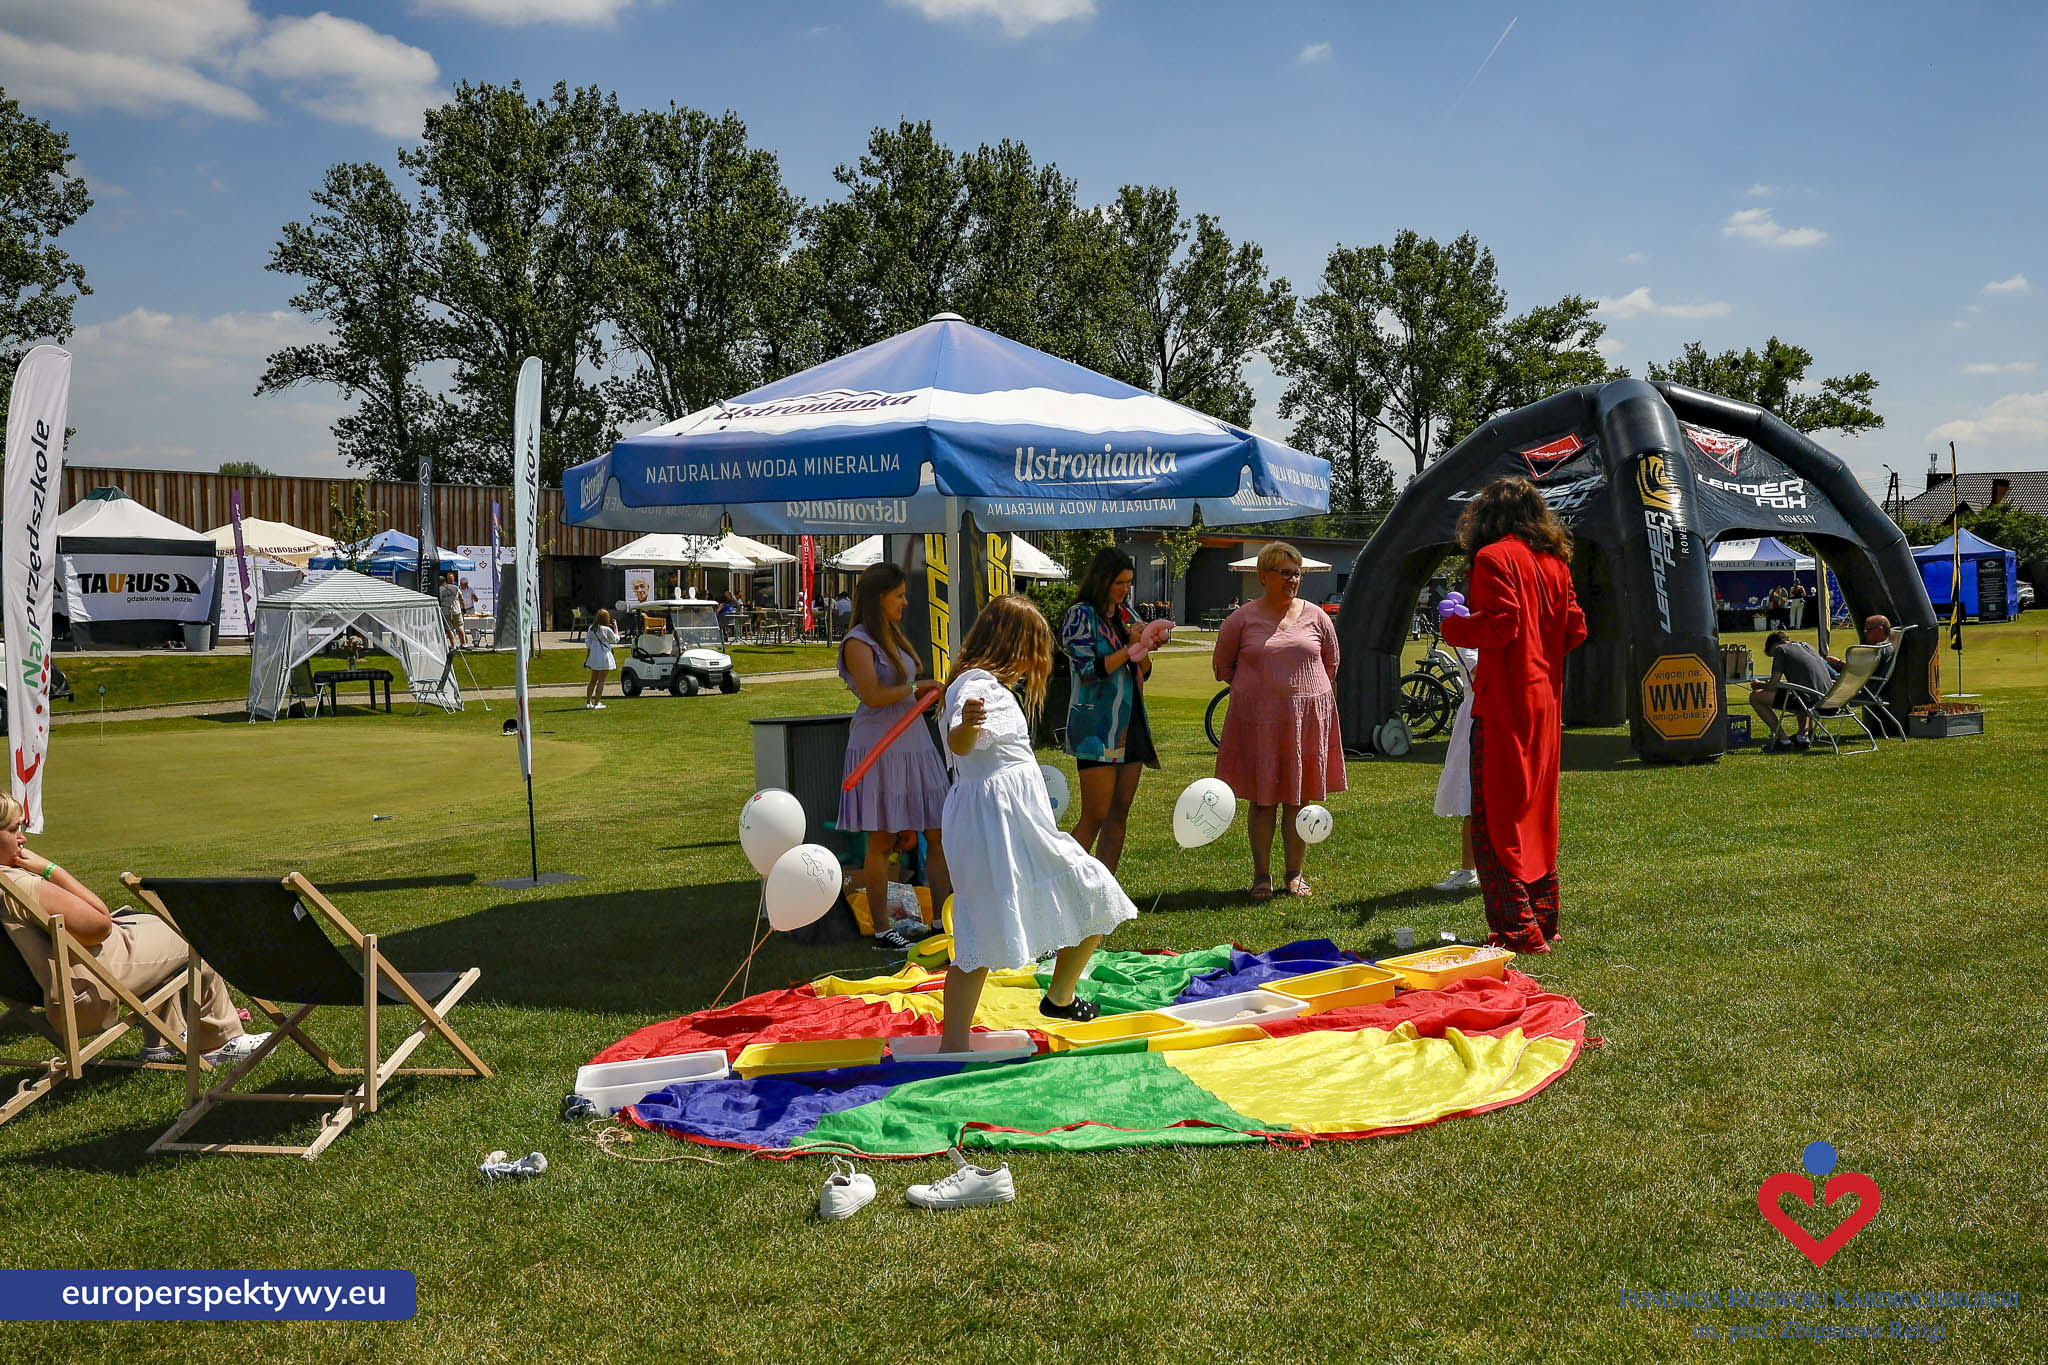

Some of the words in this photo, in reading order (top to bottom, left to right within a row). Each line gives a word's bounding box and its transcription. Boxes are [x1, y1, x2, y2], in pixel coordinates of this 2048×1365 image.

[714, 394, 918, 420] Ustronianka
[646, 461, 742, 484] NATURALNA
[747, 459, 798, 478] WODA
[804, 453, 900, 475] MINERALNA
[1014, 443, 1177, 482] Ustronianka
[1697, 474, 1804, 497] LEADER
[1778, 514, 1817, 524] ROWERY
[22, 419, 50, 688] Najprzedszkole
[259, 546, 312, 554] RACIBORSKIE
[77, 572, 170, 594] TAURUS
[1644, 510, 1672, 634] LEADER
[1655, 670, 1685, 680] więcej
[1649, 681, 1712, 712] WWW.
